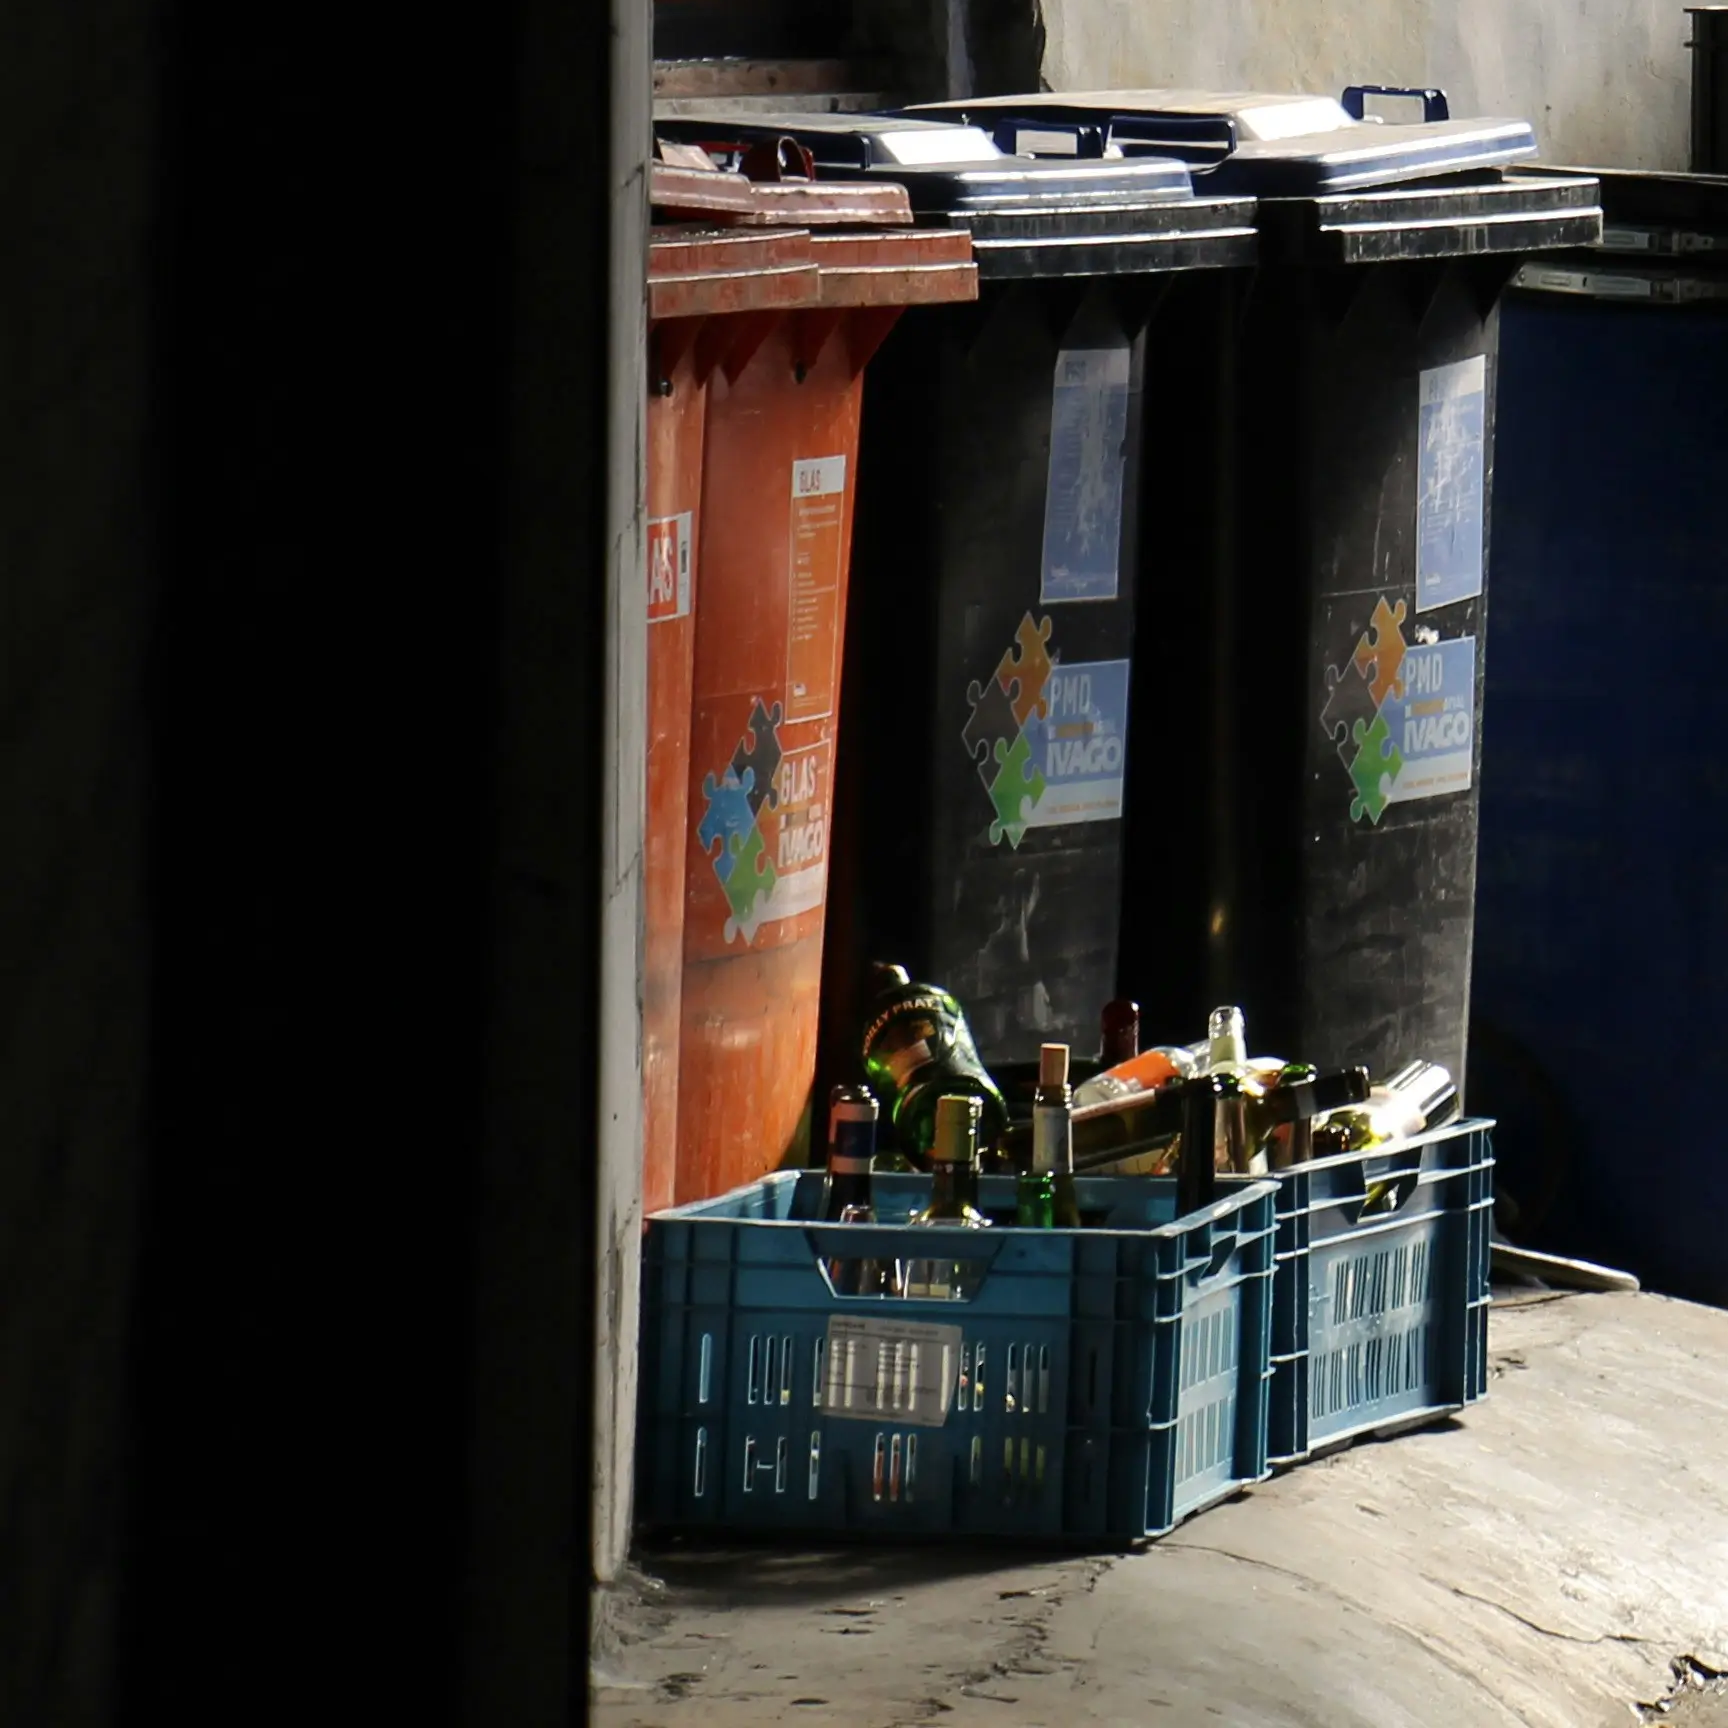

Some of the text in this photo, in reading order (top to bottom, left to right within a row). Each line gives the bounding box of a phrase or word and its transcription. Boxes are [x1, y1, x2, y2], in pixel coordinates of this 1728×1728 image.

[1050, 674, 1092, 717] PMD
[1405, 653, 1443, 696] PMD
[1404, 711, 1470, 753] IVAGO
[1047, 736, 1122, 777] IVAGO
[780, 755, 817, 805] GLAS
[778, 819, 824, 868] IVAGO
